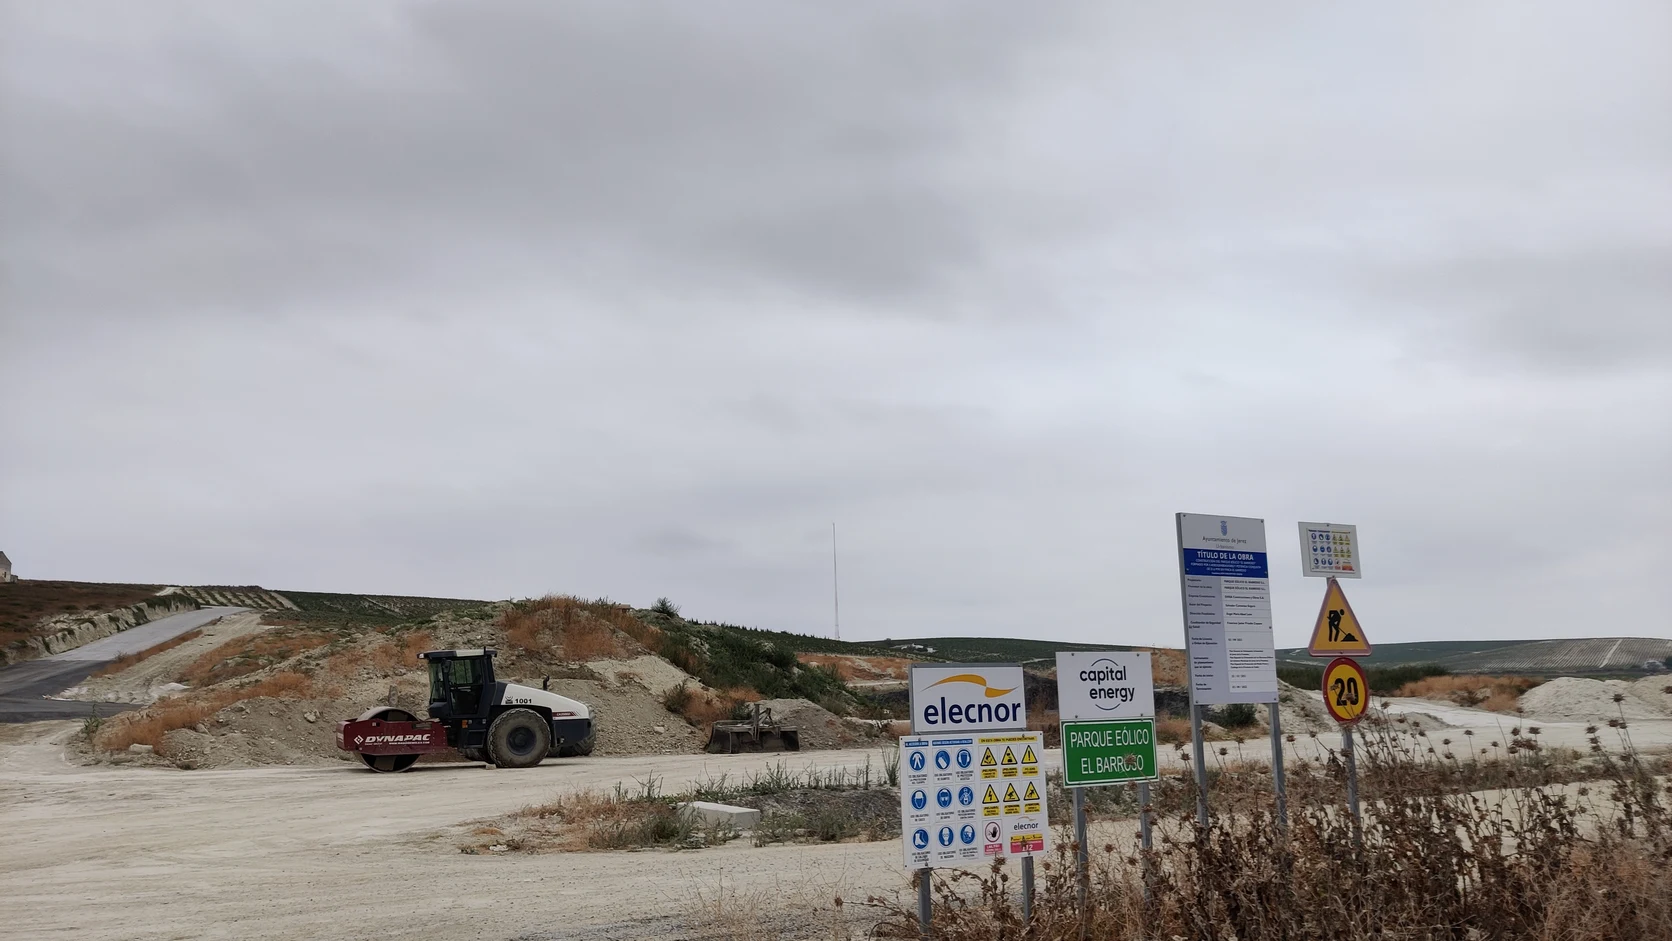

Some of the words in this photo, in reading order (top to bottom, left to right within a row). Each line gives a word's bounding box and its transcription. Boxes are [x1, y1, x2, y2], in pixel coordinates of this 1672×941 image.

[1202, 536, 1230, 544] Ayuntamiento
[1197, 550, 1218, 559] TÍTULO
[1220, 552, 1227, 560] DE
[1228, 552, 1236, 560] LA
[1237, 553, 1254, 561] OBRA
[1080, 666, 1127, 685] capital
[1089, 687, 1135, 703] energy
[1334, 677, 1359, 706] 20
[924, 696, 1021, 725] elecnor
[365, 734, 431, 743] DYNAPAC
[1070, 731, 1113, 748] PARQUE
[1115, 726, 1149, 746] EÓLICO
[1081, 757, 1094, 774] EL
[1013, 822, 1039, 831] elecnor
